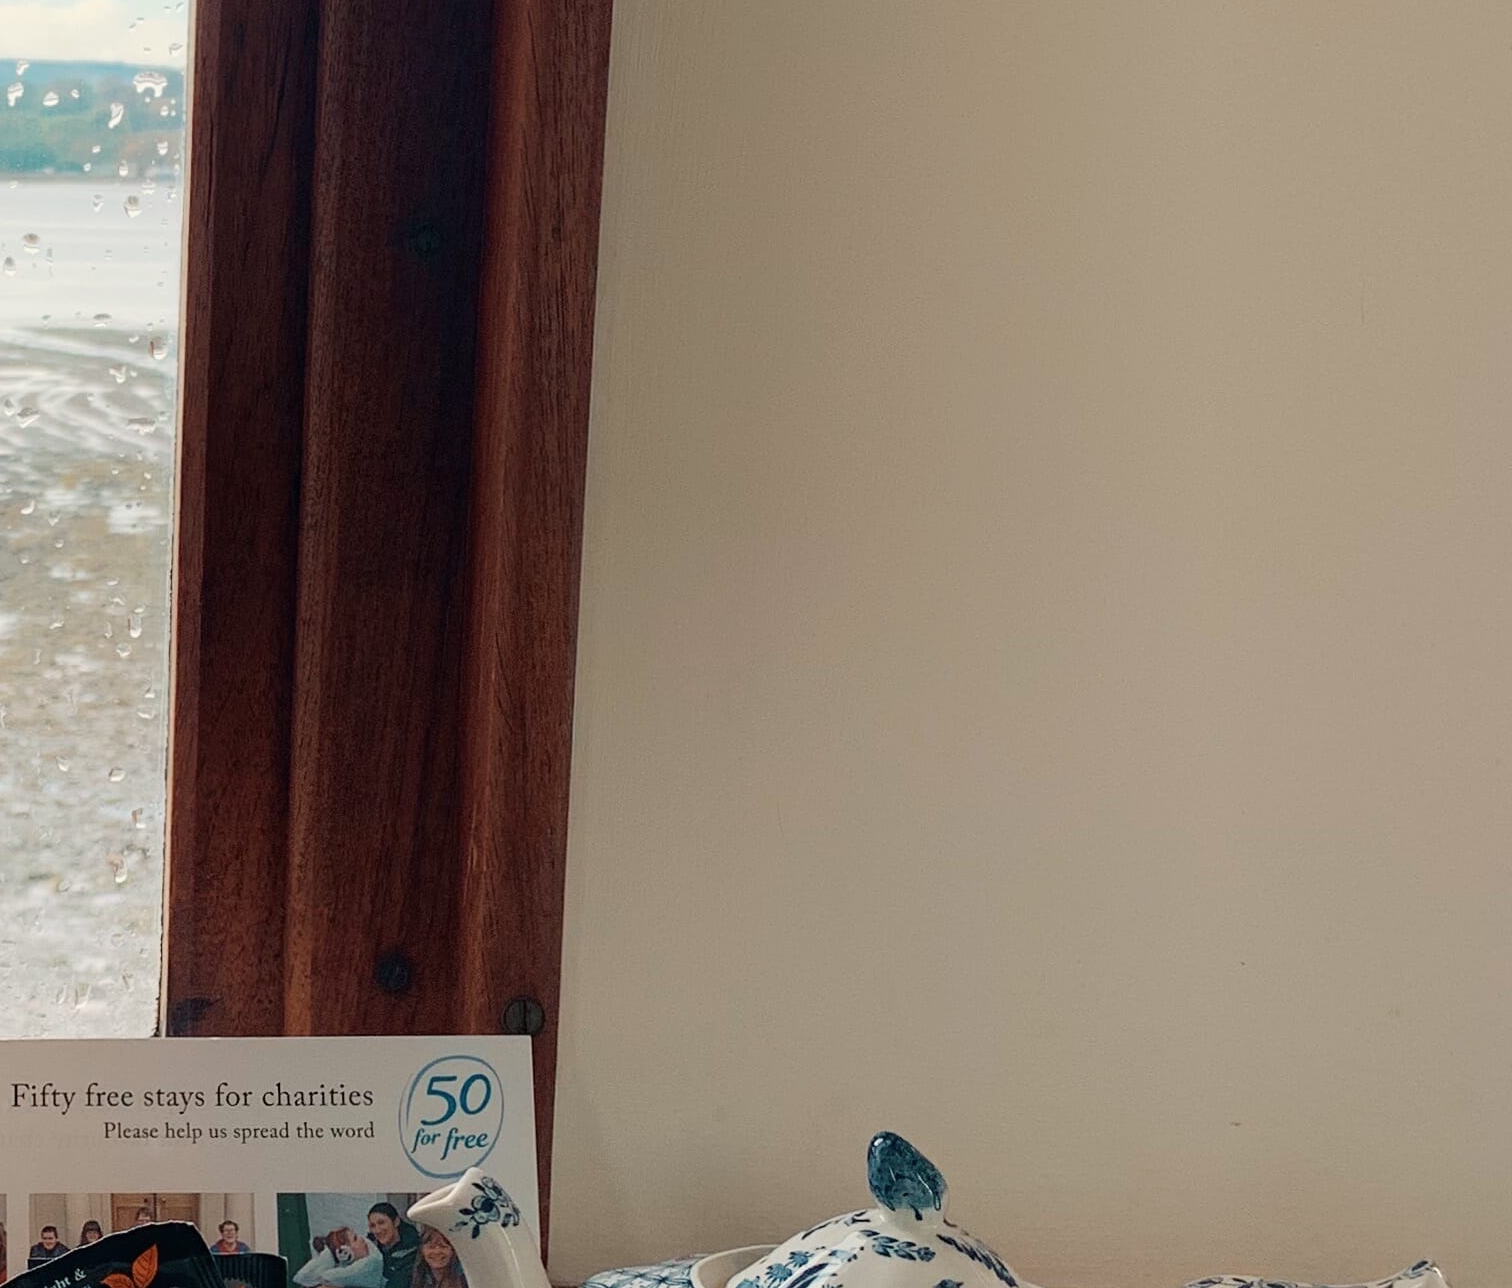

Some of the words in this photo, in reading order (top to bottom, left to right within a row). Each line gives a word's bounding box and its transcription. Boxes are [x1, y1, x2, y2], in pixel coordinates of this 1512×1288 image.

[10, 1082, 76, 1115] Fifty
[84, 1082, 134, 1108] free
[143, 1087, 205, 1115] stays
[214, 1081, 254, 1107] for
[261, 1081, 374, 1107] charities
[420, 1073, 492, 1126] 50
[103, 1121, 159, 1139] Please
[164, 1121, 203, 1144] help
[208, 1127, 228, 1139] us
[233, 1121, 290, 1144] spread
[295, 1121, 324, 1139] the
[330, 1121, 375, 1139] word
[411, 1128, 441, 1154] for
[440, 1127, 489, 1161] free
[73, 1267, 88, 1282] &
